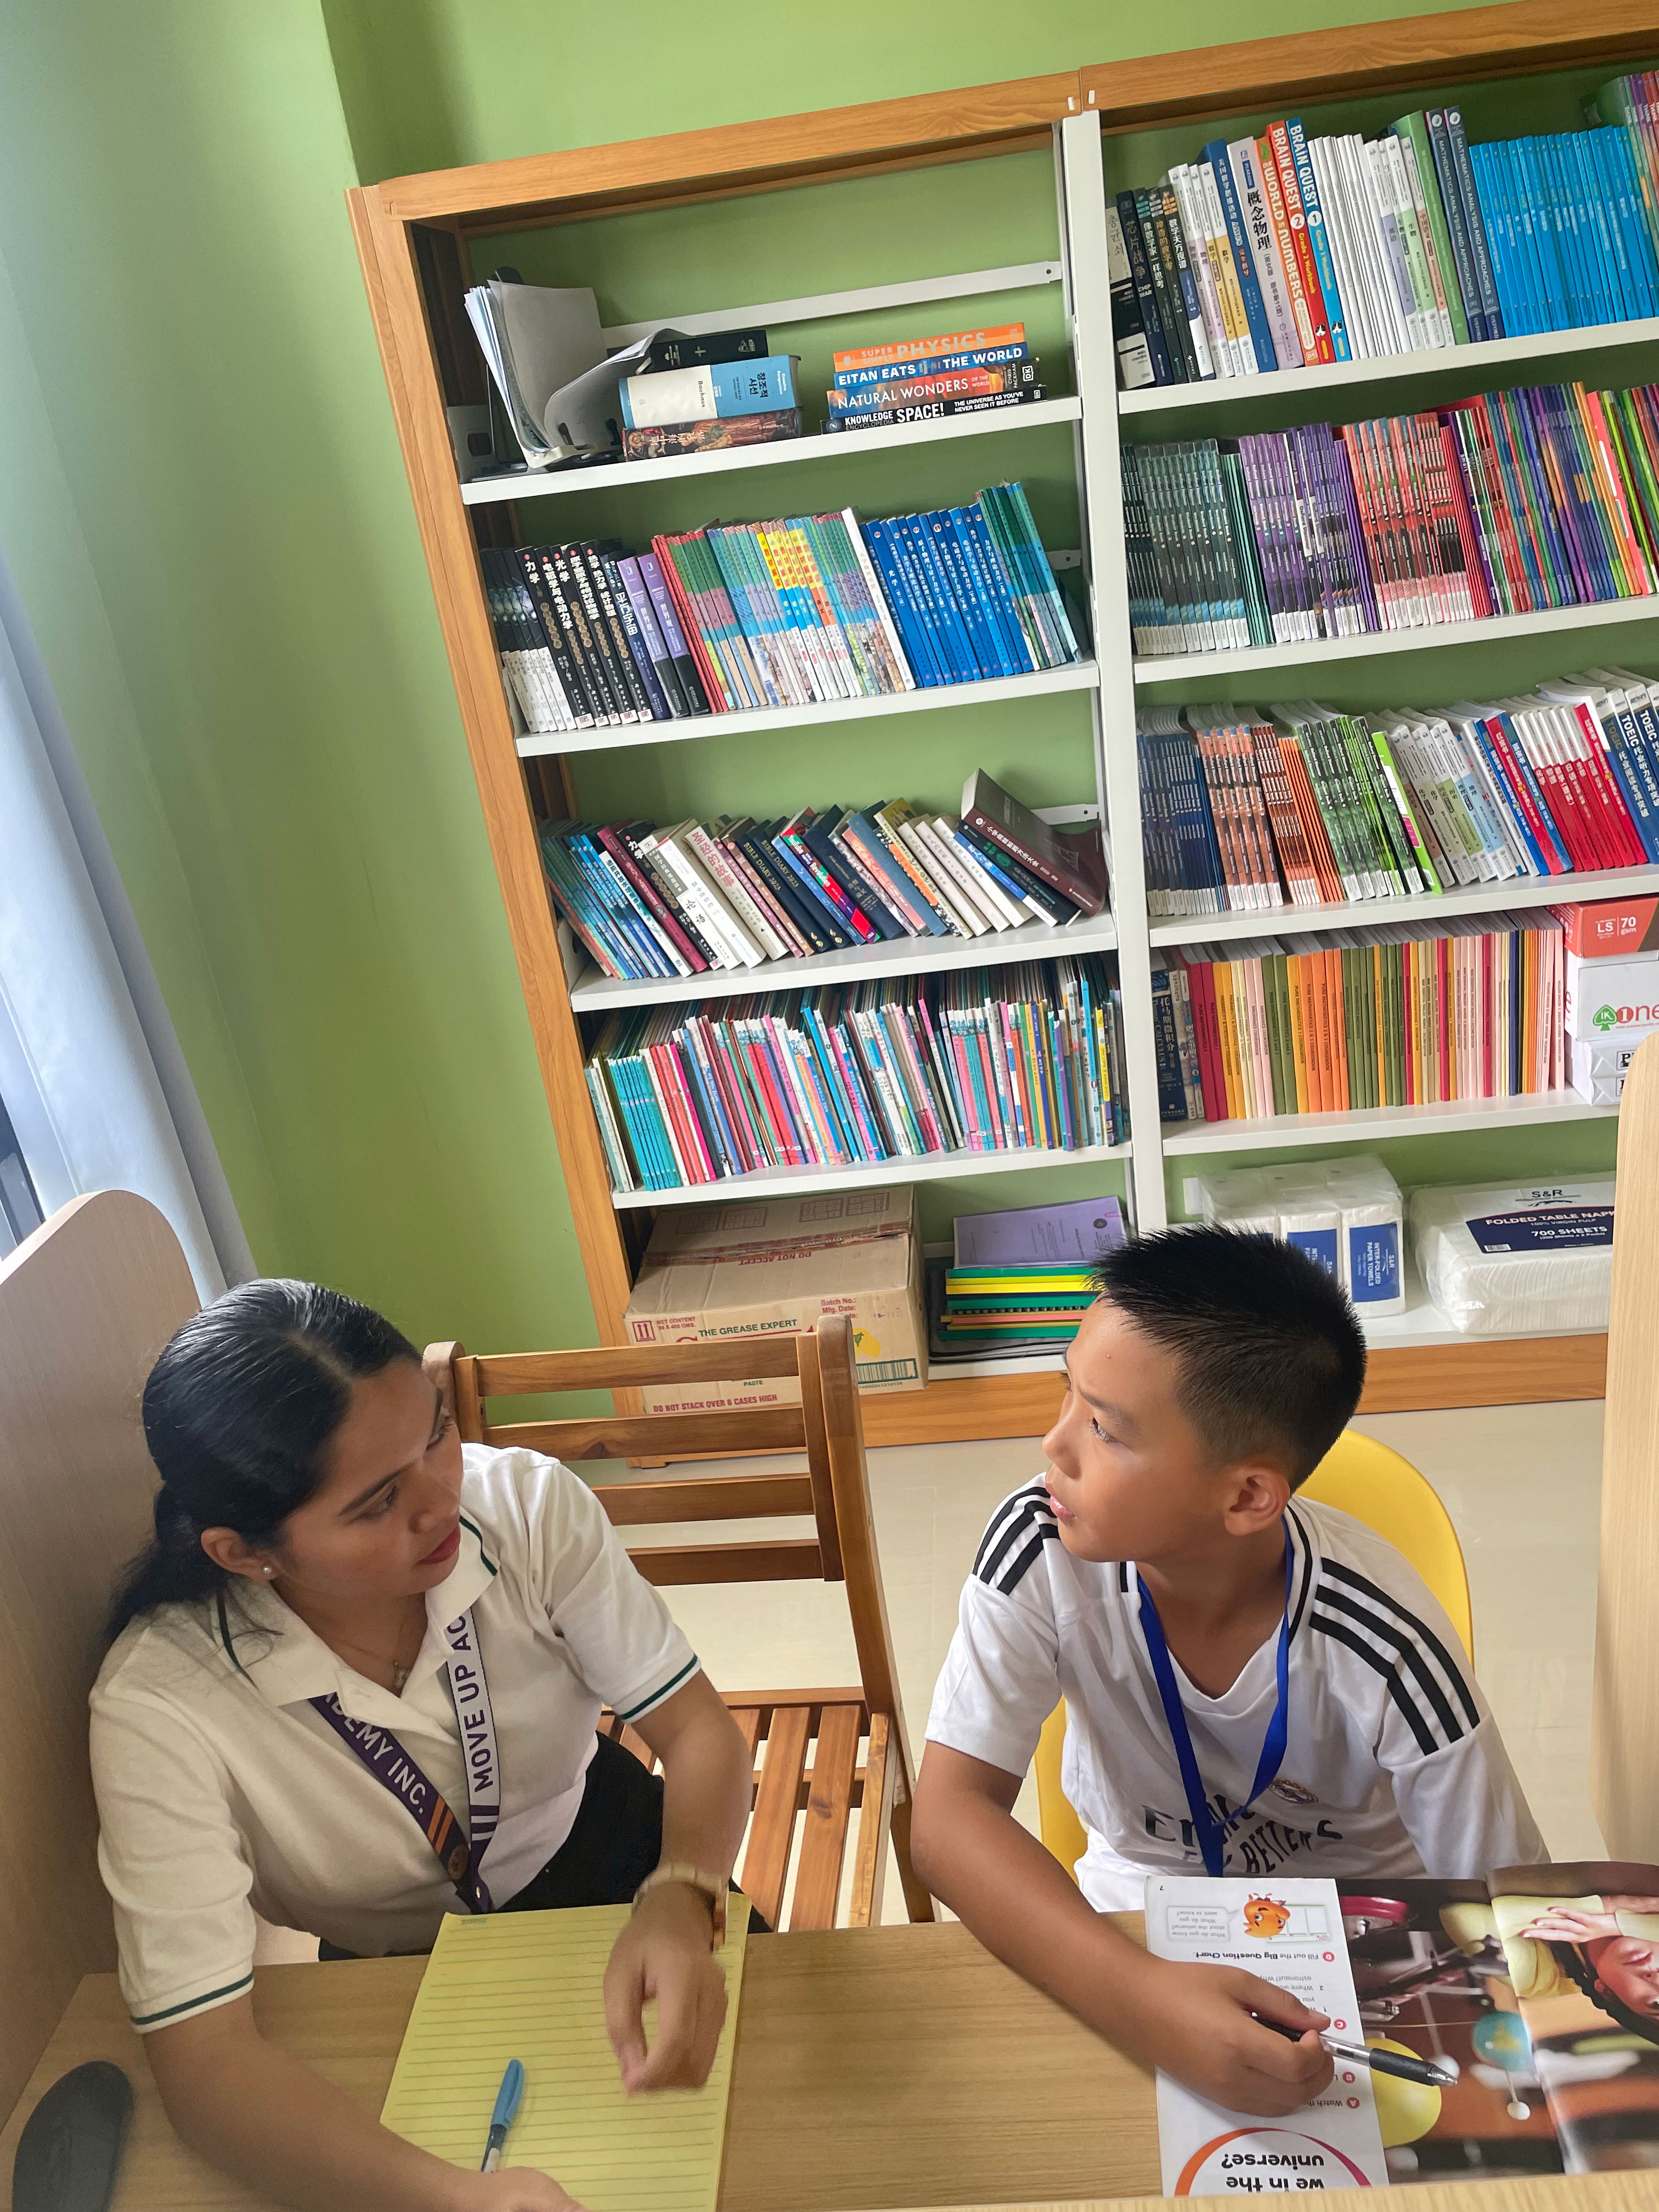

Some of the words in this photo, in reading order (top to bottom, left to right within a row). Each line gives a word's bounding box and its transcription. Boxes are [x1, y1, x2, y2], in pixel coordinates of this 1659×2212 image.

[1436, 140, 1455, 195] MATHEMATICS
[1454, 137, 1473, 193] MATHEMATICS
[1263, 168, 1284, 221] WORLD
[1282, 170, 1301, 210] QUEST
[1299, 166, 1318, 207] QUEST
[1247, 189, 1272, 251] 概念物理
[1448, 194, 1462, 232] ANALYSIS
[1465, 192, 1480, 229] ANALYSIS
[1125, 219, 1146, 279] 芯片战争
[1455, 231, 1465, 247] AND
[1473, 229, 1483, 245] AND
[1298, 233, 1307, 254] Grade
[1305, 258, 1316, 295] Workbook
[1458, 247, 1476, 298] APPROACHES
[1475, 245, 1493, 296] APPROACHES
[1138, 284, 1152, 292] CHIP
[1138, 290, 1153, 298] WAR
[1488, 314, 1500, 340] OXFORD
[861, 347, 893, 357] SUPER
[896, 332, 986, 359] PHYSICS
[838, 371, 878, 386] EITAN
[882, 364, 916, 379] EATS
[943, 356, 969, 369] THE
[973, 347, 1022, 364] WORLD
[862, 354, 894, 365] SIMPLE
[697, 380, 706, 408] Bauhaus
[748, 377, 759, 396] 시선
[757, 371, 769, 398] 창조적
[838, 390, 897, 409] NATURAL
[900, 378, 969, 399] WONDERS
[896, 402, 945, 423] SPACE!
[966, 396, 994, 405] UNIVERSE
[996, 398, 1019, 406] BEFORE
[845, 410, 894, 426] KNOWLEDGE
[845, 419, 894, 431] ENCYCLOPEDIA
[1298, 505, 1307, 527] Oxford
[524, 559, 541, 585] 力学
[554, 557, 571, 584] 光学
[609, 559, 625, 591] Parallel
[541, 561, 574, 632] 电磁学与电动力学
[614, 590, 639, 638] 平行宇宙
[1583, 717, 1598, 742] 红宝书
[1607, 720, 1623, 750] TOEIC
[1621, 714, 1639, 747] TOEIC
[1639, 710, 1658, 741] TOEIC
[1495, 731, 1510, 755] 红宝书
[1430, 789, 1439, 802] 化学
[1448, 788, 1458, 800] 历史
[626, 838, 647, 862] 力学
[786, 832, 806, 856] YouTube
[966, 842, 994, 872] 老人与海
[690, 828, 737, 891] 圣经的故事
[742, 841, 759, 861] BIBLE
[754, 858, 772, 879] DIARY
[760, 838, 776, 858] BIBLE
[772, 855, 790, 876] DIARY
[786, 873, 800, 889] 2023
[809, 860, 833, 890] Revolution
[683, 896, 708, 927] 论语
[1621, 917, 1637, 929] 70
[1597, 922, 1613, 934] LS
[1621, 927, 1637, 936] gsm
[1294, 998, 1304, 1031] MATHEMATICS
[1305, 996, 1316, 1029] MATHEMATICS
[1319, 995, 1330, 1029] MATHEMATICS
[1154, 1024, 1166, 1063] CALCULUS
[1297, 1035, 1306, 1065] COURSEBOOK
[1307, 1041, 1317, 1072] COURSEBOOK
[1322, 1041, 1331, 1071] COURSEBOOK
[1531, 1189, 1563, 1198] S&R
[1485, 1216, 1537, 1226] FOLDED
[1539, 1213, 1579, 1221] TABLE
[1558, 1226, 1608, 1235] SHEETS
[738, 1256, 775, 1266] ACCEPT
[822, 1305, 837, 1314] Mfg.
[698, 1329, 717, 1338] THE
[719, 1324, 758, 1335] GREASE
[760, 1319, 798, 1330] EXPERT
[665, 1404, 680, 1412] NOT
[681, 1402, 704, 1410] STACK
[706, 1400, 726, 1408] OVER
[734, 1396, 758, 1406] CASES
[759, 1394, 778, 1402] HIGH
[454, 1664, 480, 1704] UP
[464, 1709, 494, 1793] MOVE
[387, 1757, 427, 1815] INC.
[1222, 1951, 1262, 1959] Question
[1264, 1951, 1278, 1959] Big
[1316, 2099, 1343, 2107] Watch
[1220, 2152, 1325, 2169] universe?
[1226, 2176, 1262, 2192] the
[1268, 2177, 1289, 2192] in
[1295, 2177, 1324, 2190] we
